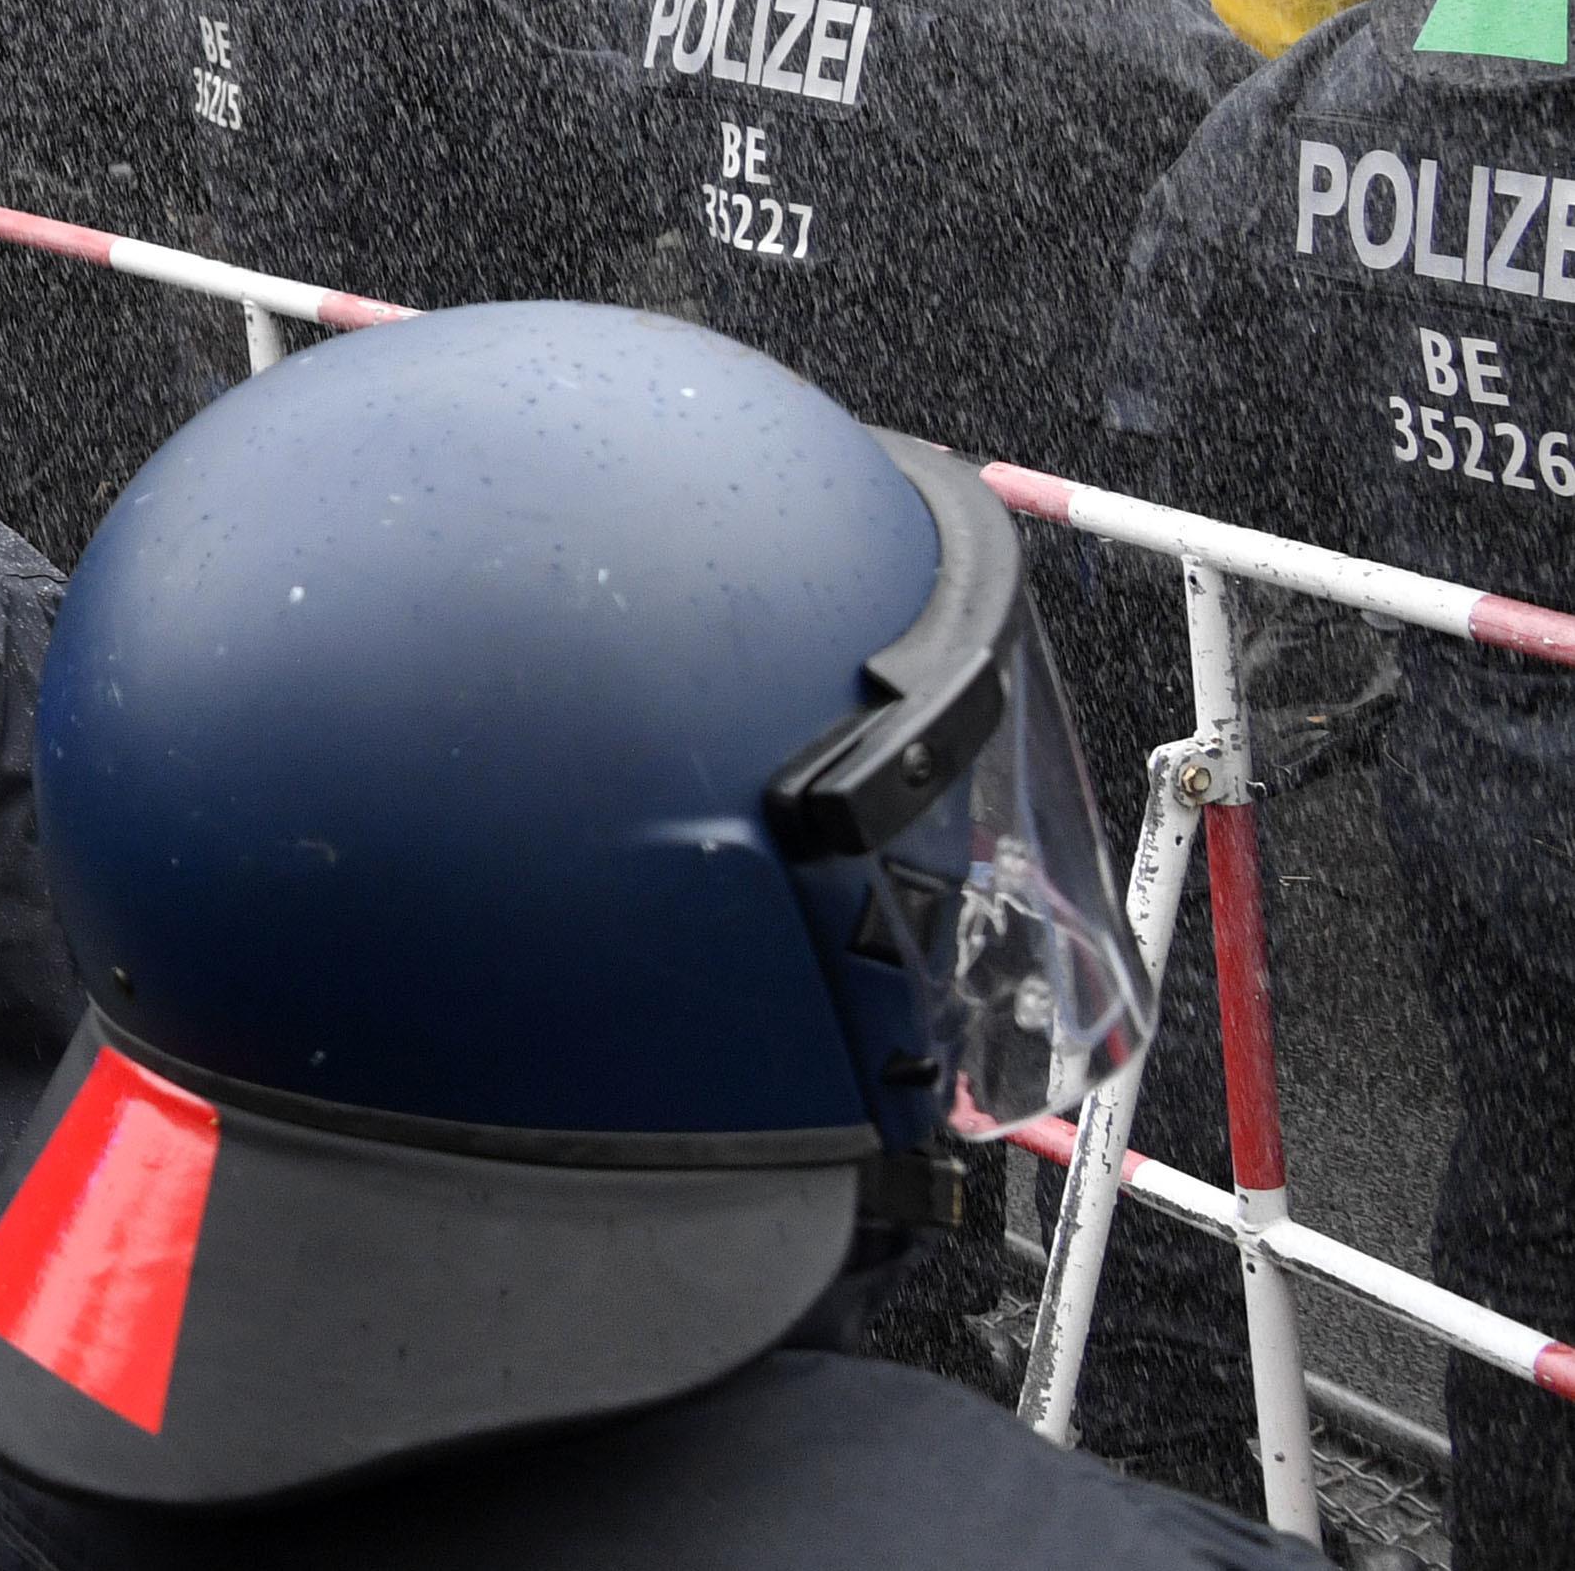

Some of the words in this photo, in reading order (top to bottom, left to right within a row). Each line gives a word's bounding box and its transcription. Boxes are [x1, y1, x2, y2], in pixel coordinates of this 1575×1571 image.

[199, 15, 232, 69] BE
[720, 121, 771, 185] BE
[702, 183, 814, 259] 35227
[1419, 327, 1510, 407] BE
[1388, 396, 1575, 498] 35226
